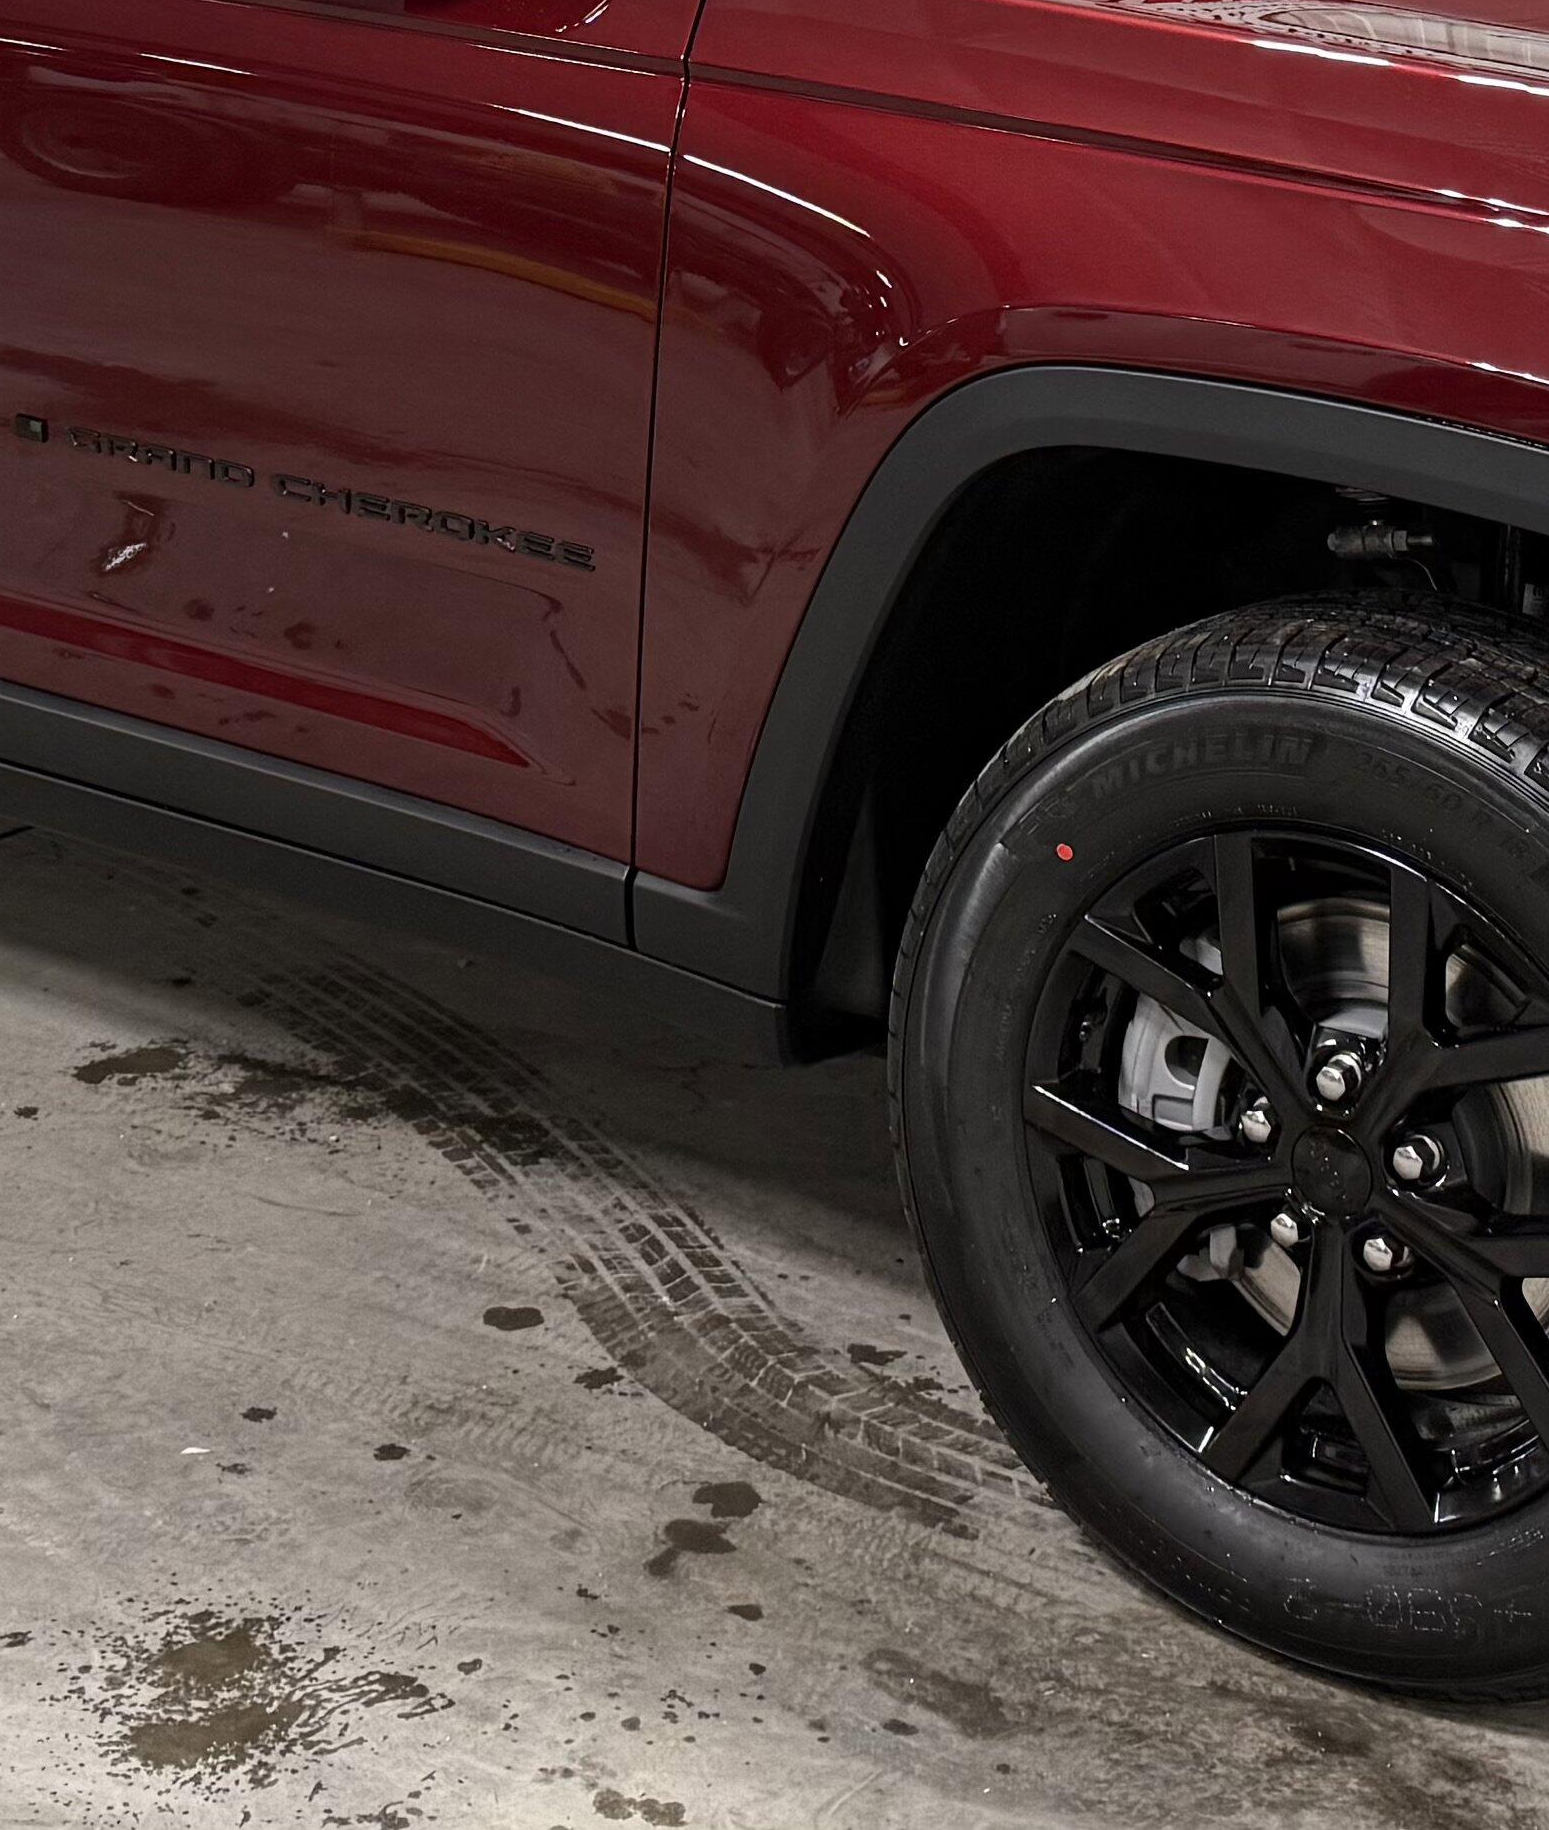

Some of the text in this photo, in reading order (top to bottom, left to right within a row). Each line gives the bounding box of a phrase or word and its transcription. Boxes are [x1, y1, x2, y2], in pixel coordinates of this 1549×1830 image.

[65, 426, 597, 571] GRAND CHEROKEE
[1091, 732, 1314, 799] MICHELIN
